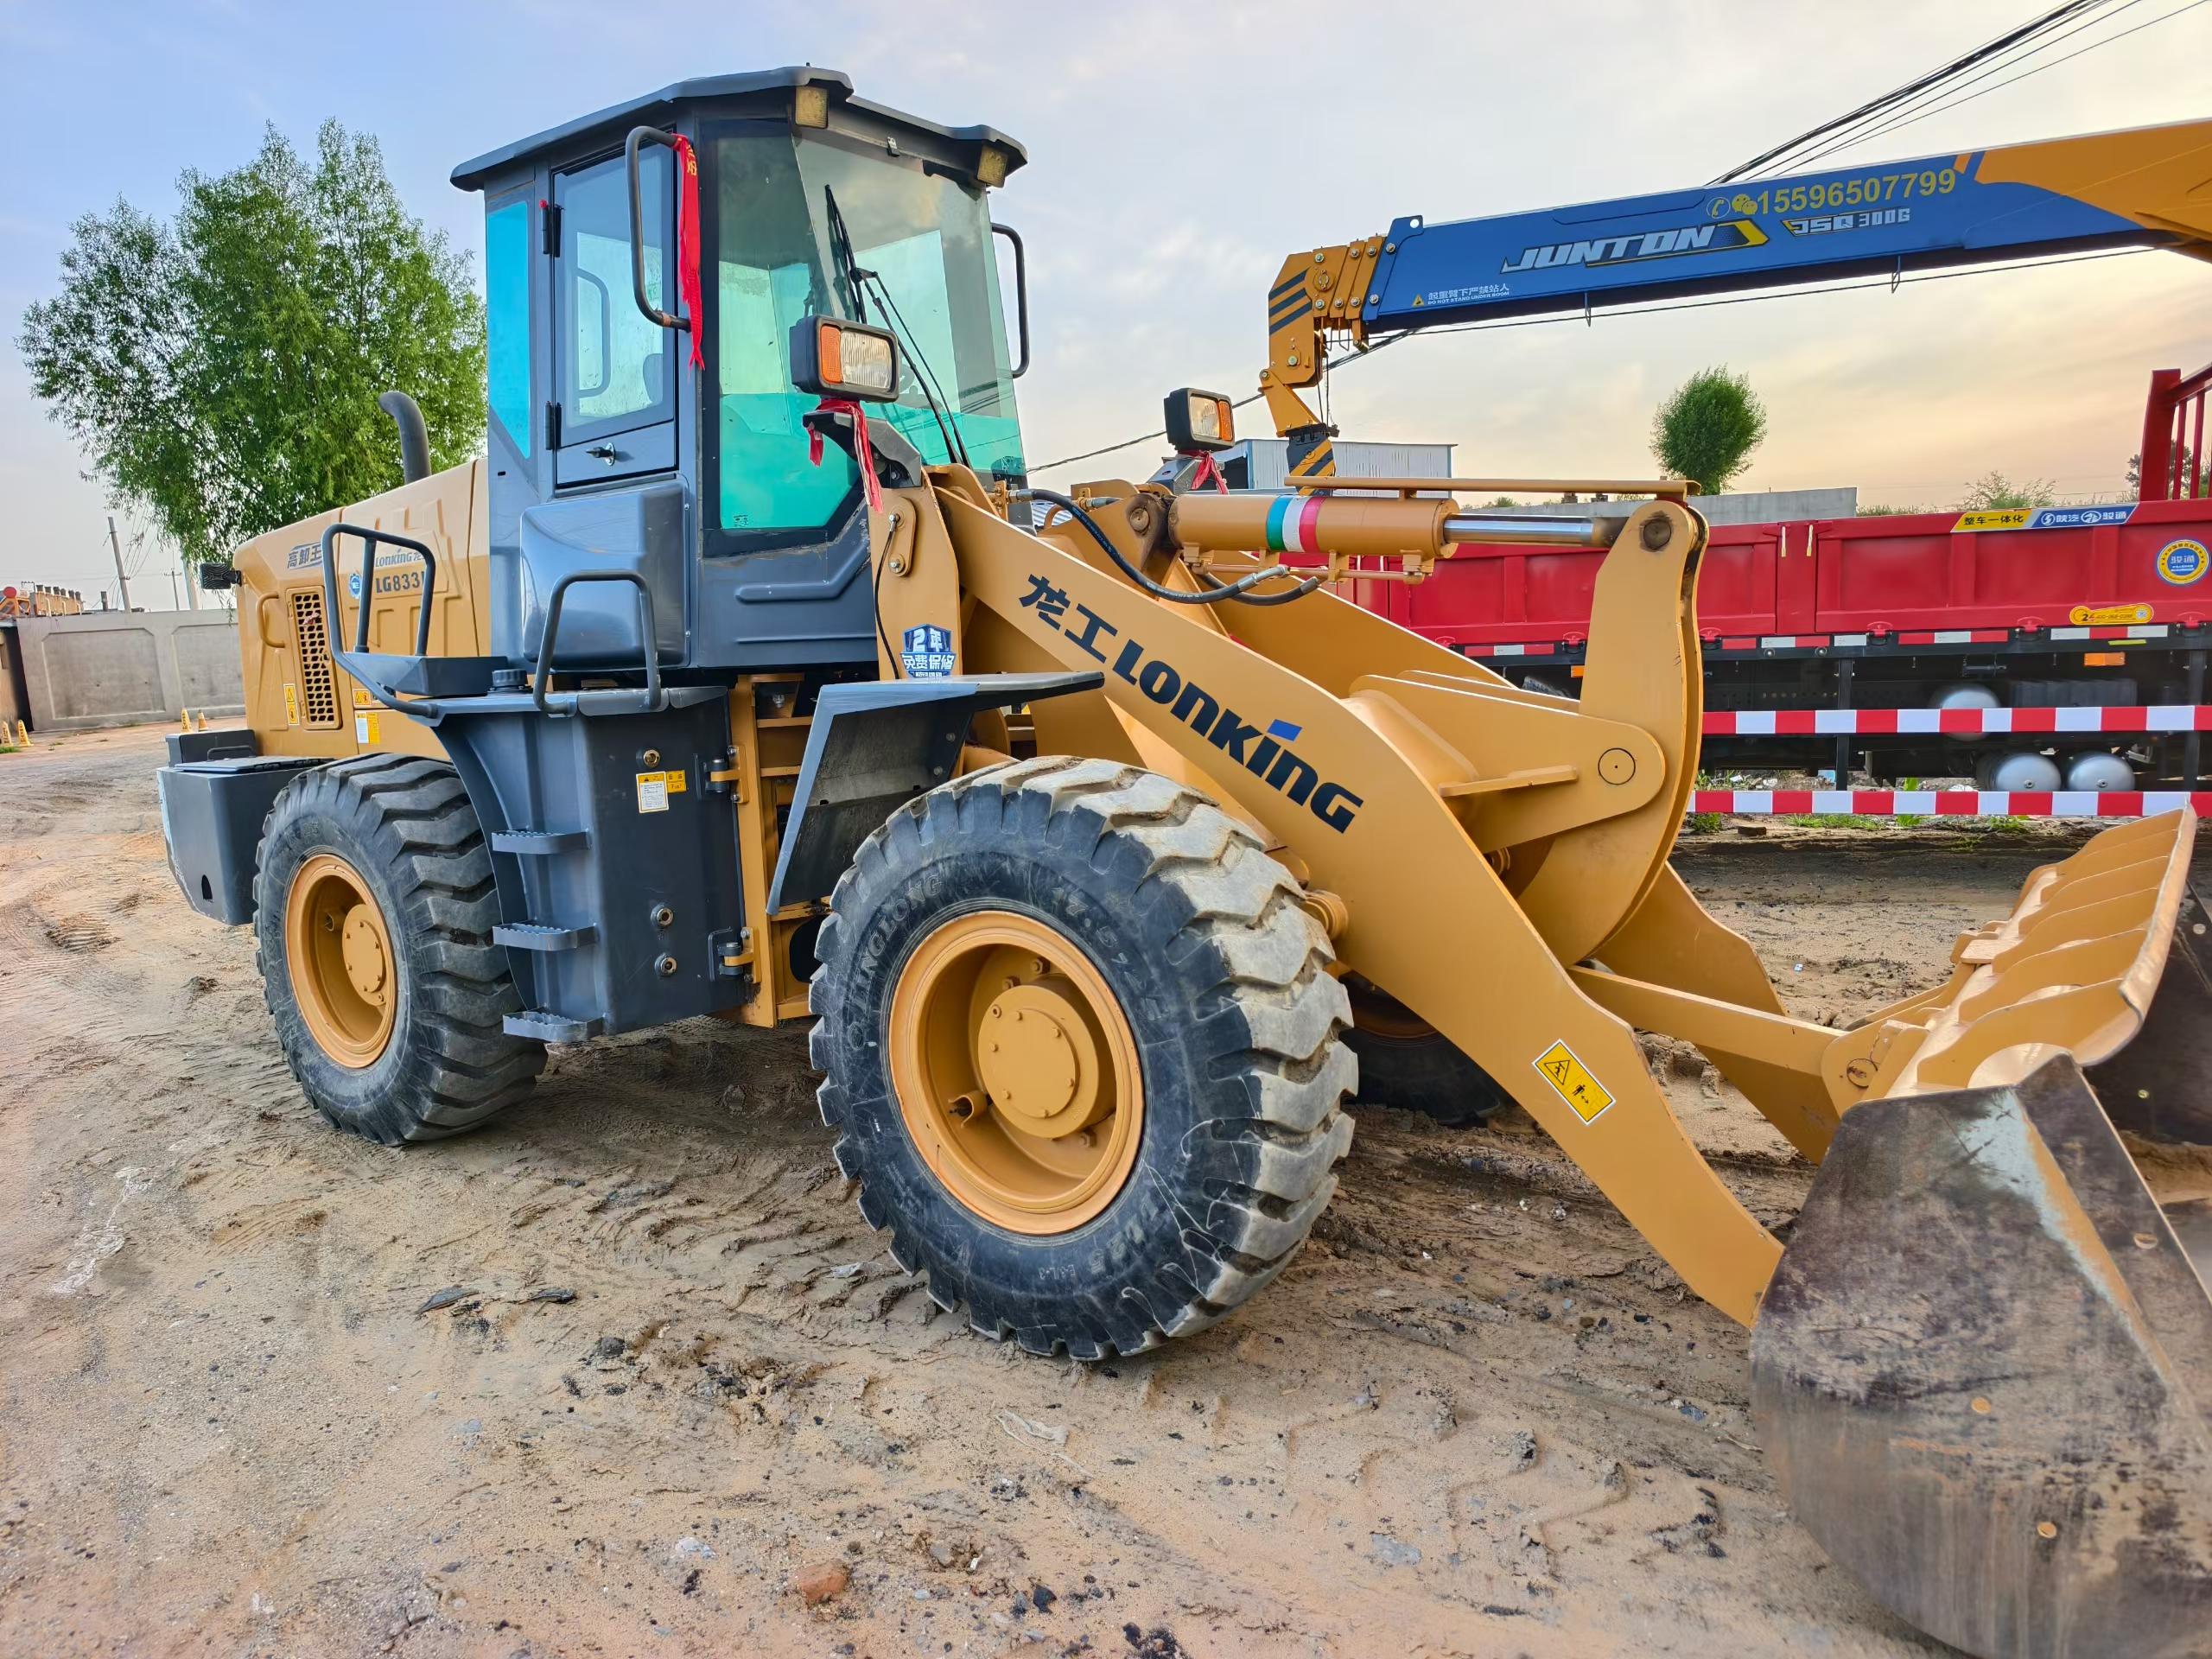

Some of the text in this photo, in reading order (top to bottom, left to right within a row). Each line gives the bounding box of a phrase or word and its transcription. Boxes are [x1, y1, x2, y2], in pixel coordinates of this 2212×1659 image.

[1758, 168, 1955, 215] 15596507799
[1501, 225, 1716, 273] JUNTON
[1428, 283, 1510, 301] 起重臂下严禁站人
[1964, 514, 2024, 525] 整车一体化
[288, 545, 321, 569] 高卸王
[912, 627, 943, 652] 2年
[901, 654, 955, 670] 免费保修
[1019, 574, 1363, 834] 龙工 LONKING
